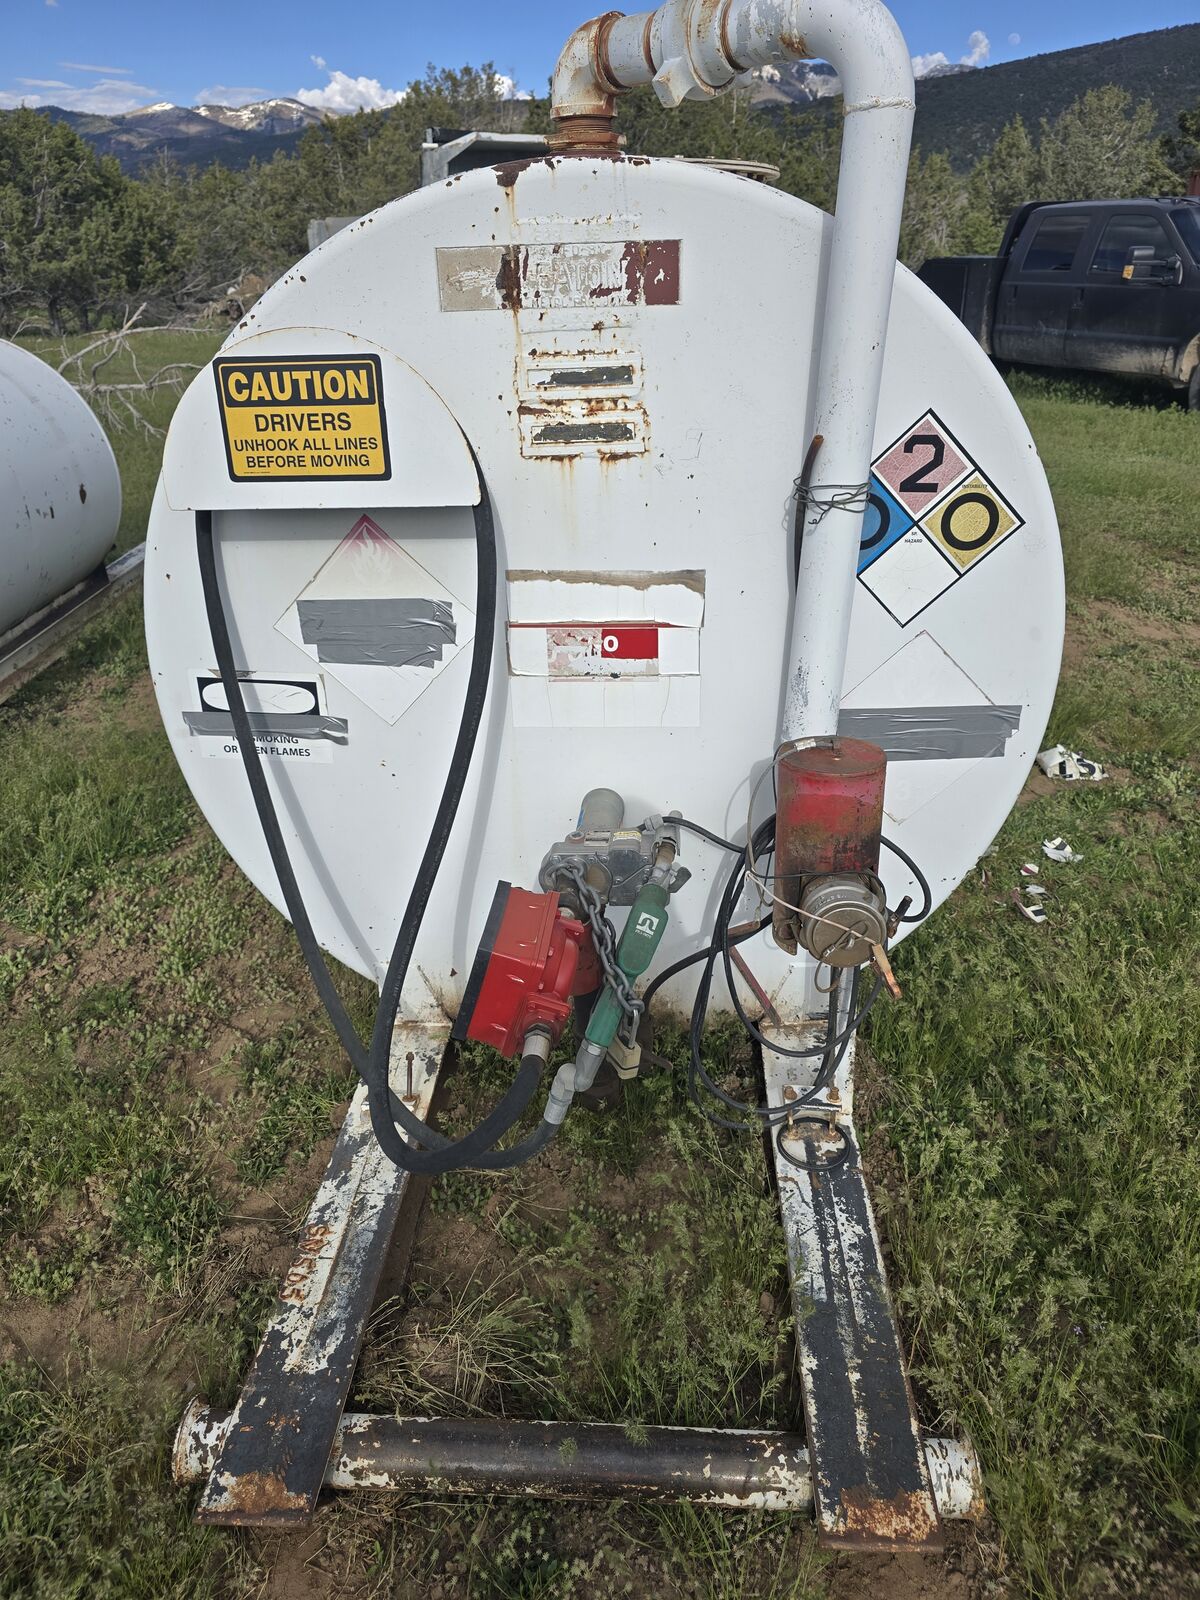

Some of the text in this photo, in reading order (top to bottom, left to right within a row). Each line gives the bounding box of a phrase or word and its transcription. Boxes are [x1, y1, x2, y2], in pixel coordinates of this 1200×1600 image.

[228, 369, 369, 401] CAUTION
[254, 412, 352, 432] DRIVERS
[234, 437, 378, 451] UNHOOK ALL LINES
[246, 454, 370, 468] BEFORE MOVING
[899, 434, 945, 493] 2
[223, 745, 238, 753] OR
[270, 746, 311, 757] FLAMES
